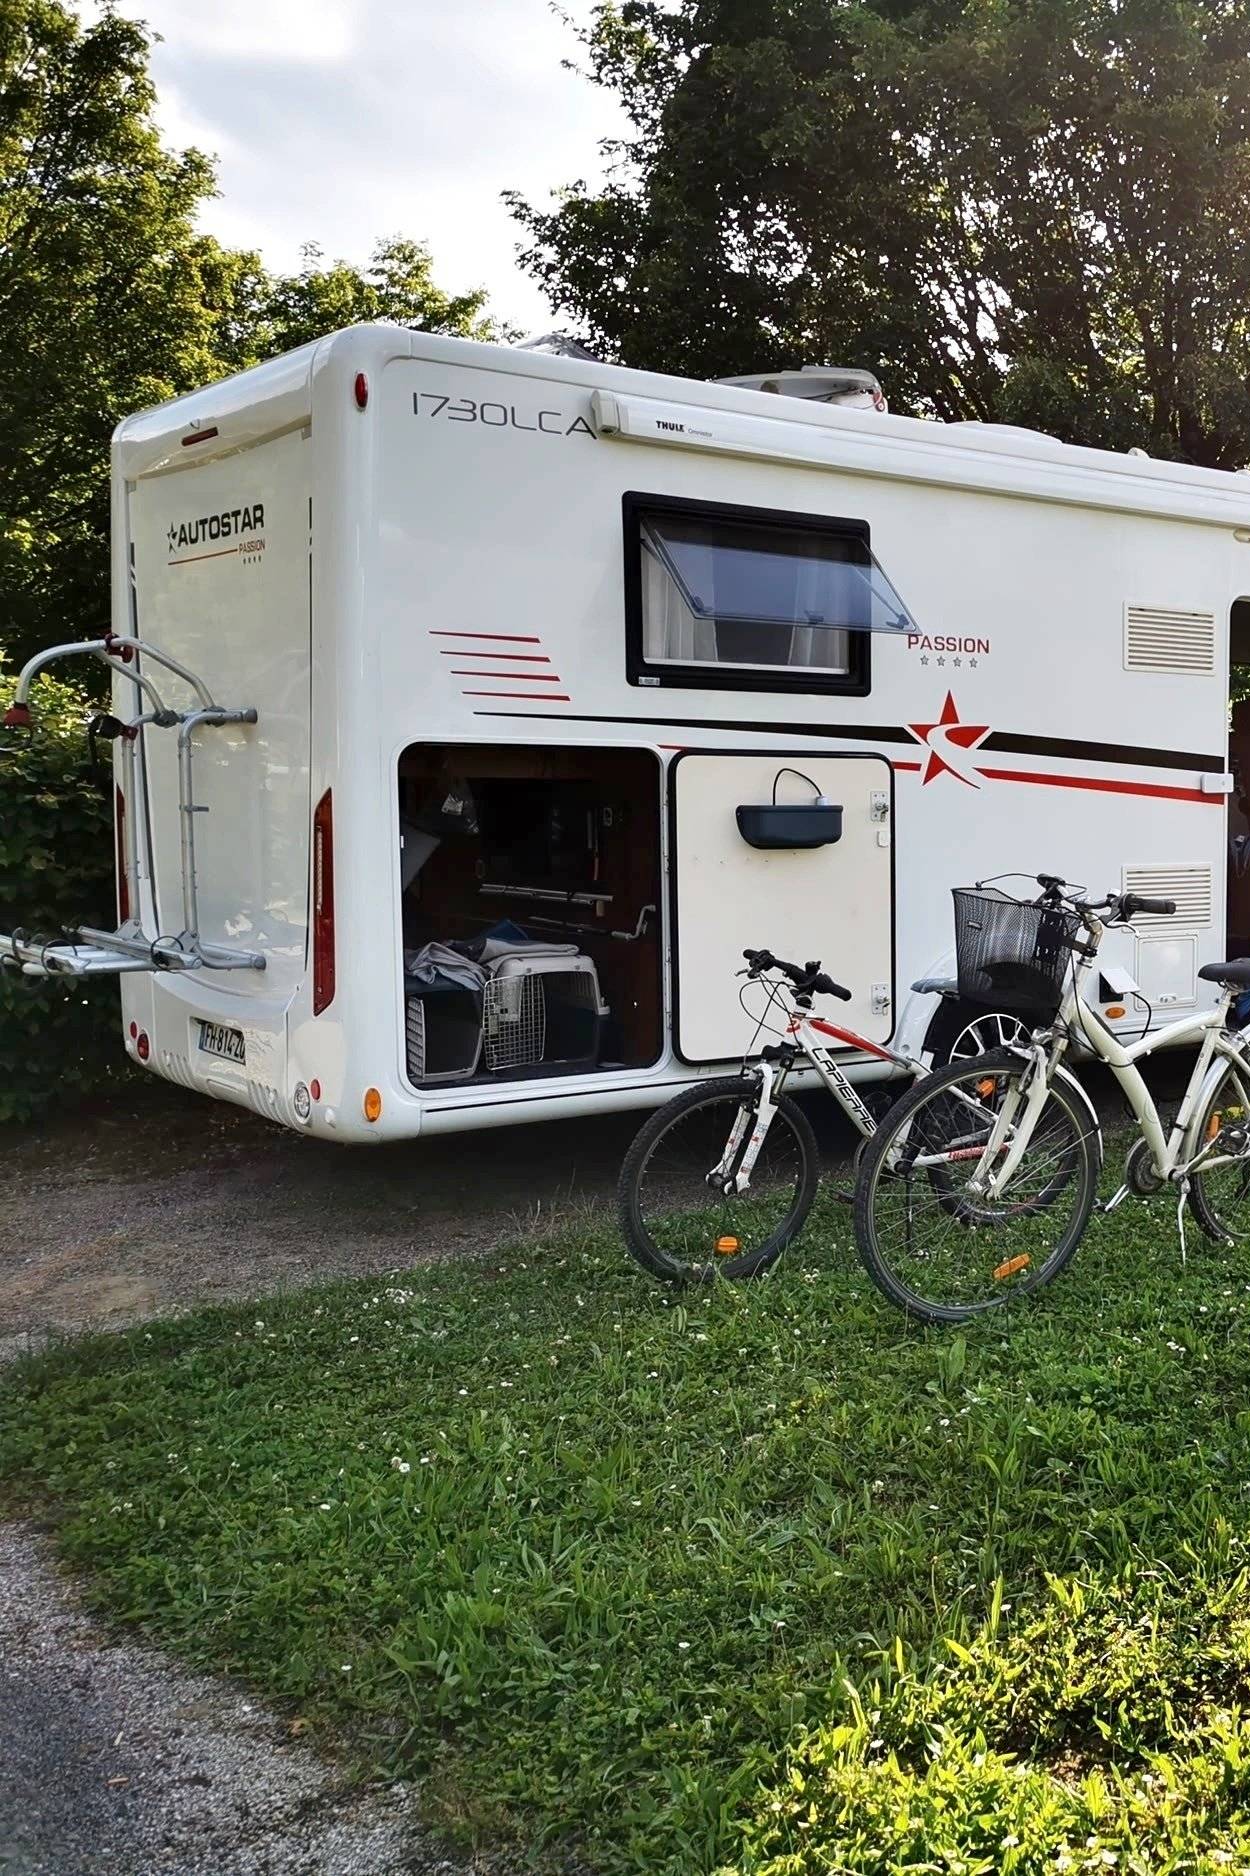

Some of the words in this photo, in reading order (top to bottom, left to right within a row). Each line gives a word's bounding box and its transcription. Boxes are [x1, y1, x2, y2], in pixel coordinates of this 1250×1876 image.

[656, 421, 685, 432] THULE
[178, 504, 264, 547] AUTOSTAR
[908, 634, 989, 653] PASSION
[812, 1047, 879, 1132] LAPIERRE
